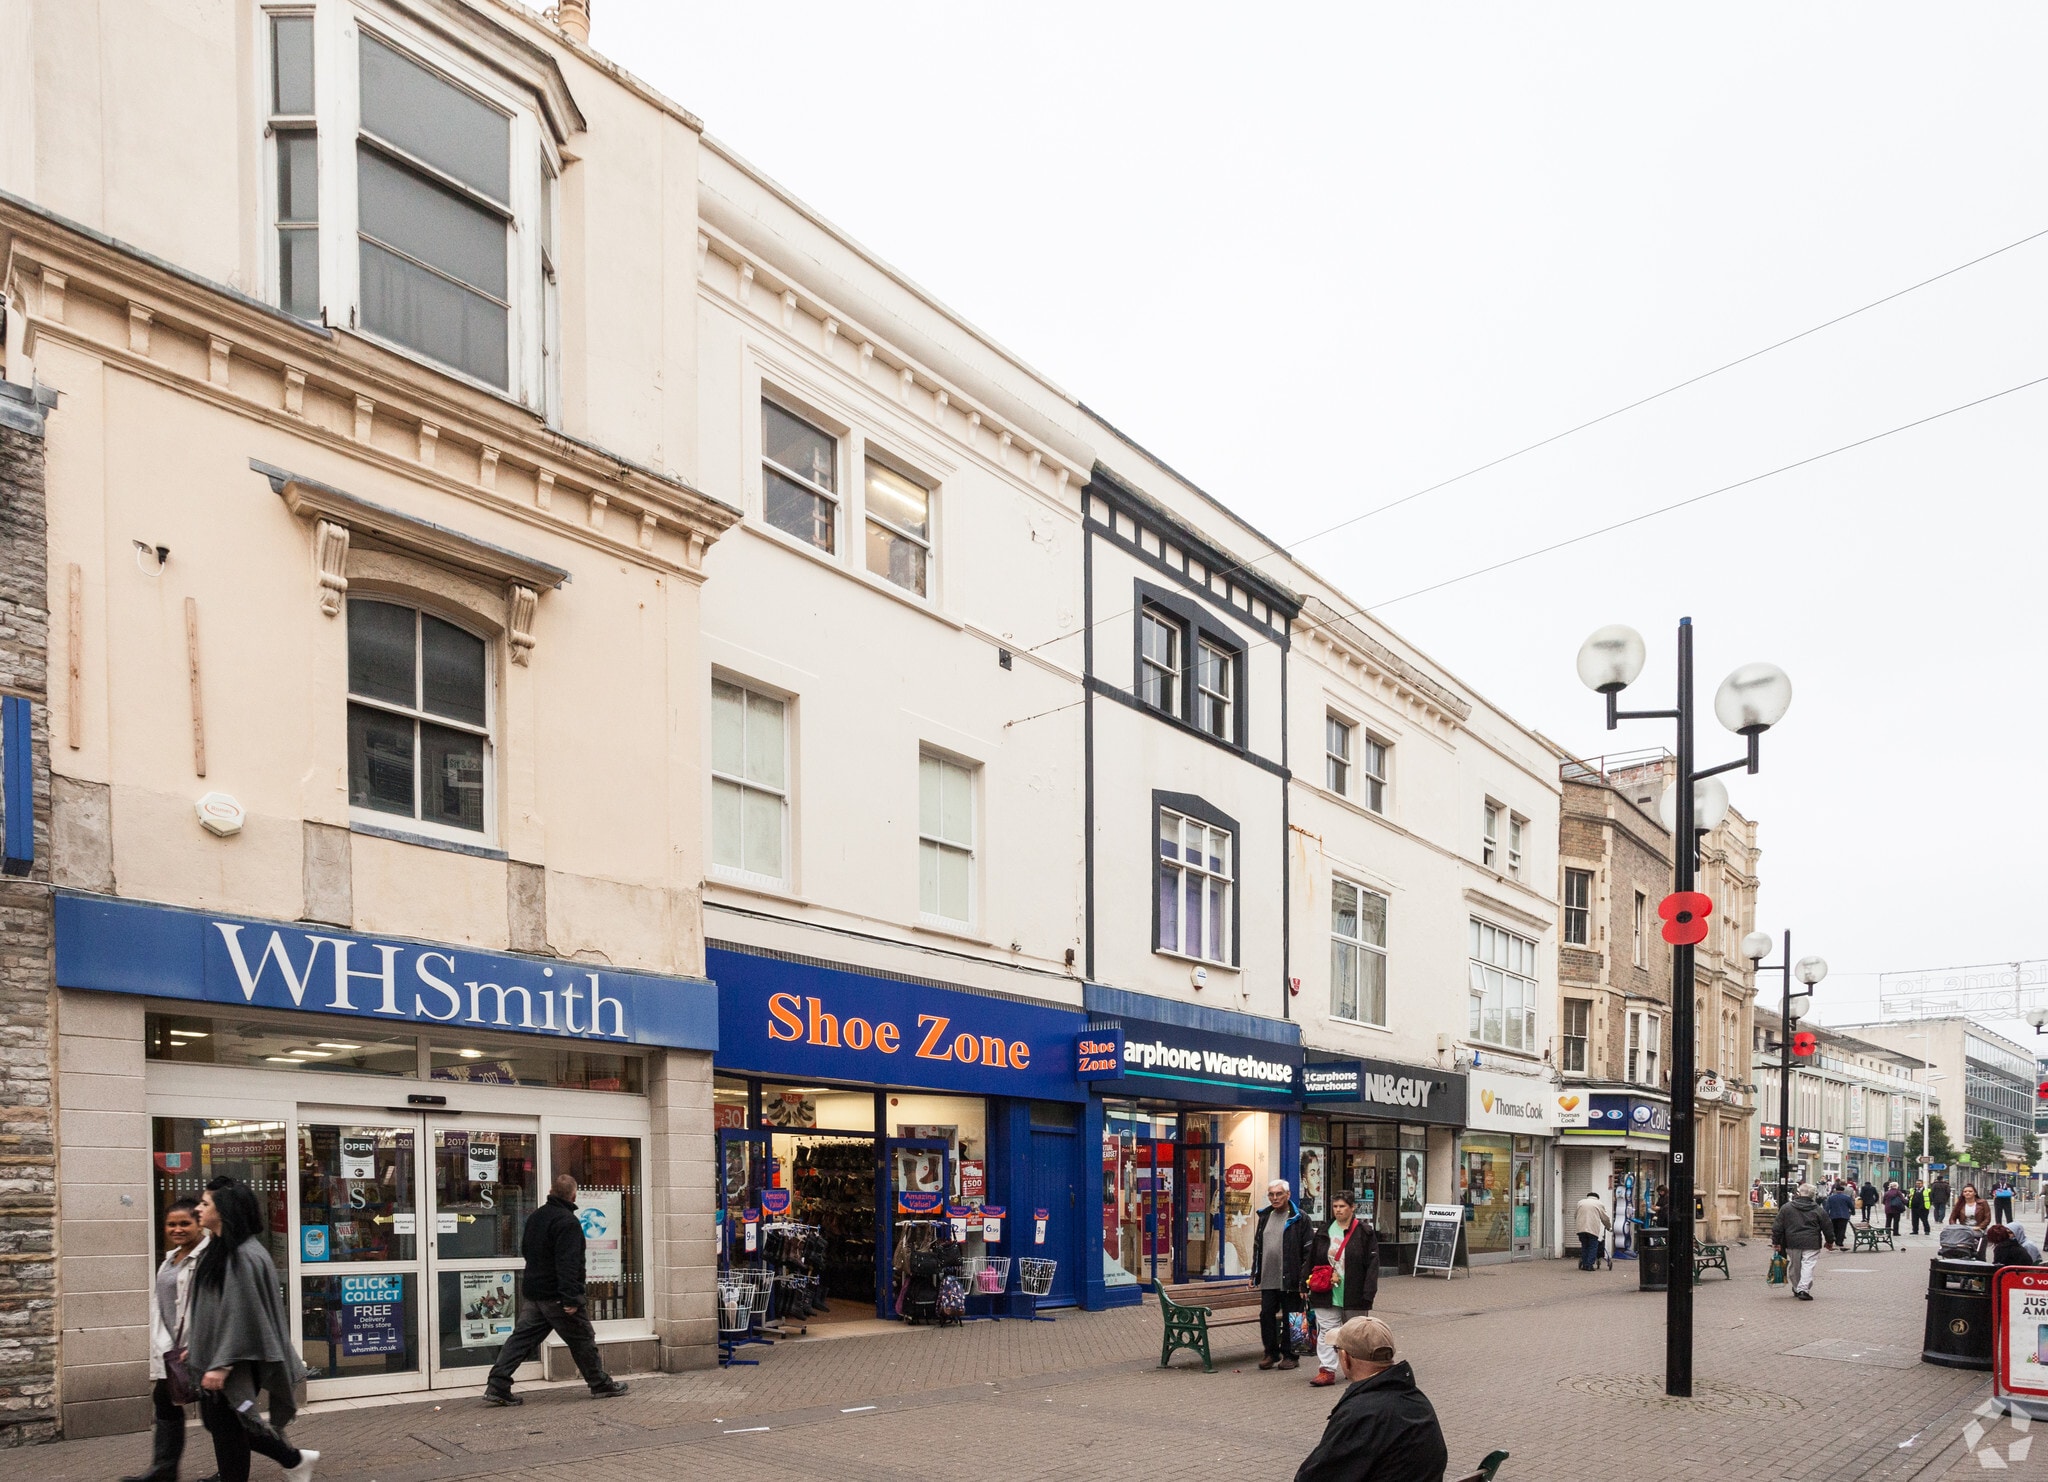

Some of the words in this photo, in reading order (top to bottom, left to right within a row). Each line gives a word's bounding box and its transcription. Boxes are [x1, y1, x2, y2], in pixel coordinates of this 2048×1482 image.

[212, 922, 630, 1039] WHSmith
[767, 992, 900, 1054] Shoe
[915, 1013, 1031, 1070] Zone
[1079, 1040, 1116, 1055] Shoe
[1078, 1057, 1117, 1072] Zone
[1123, 1041, 1201, 1070] arphone
[1202, 1050, 1293, 1083] Warehouse
[1310, 1071, 1357, 1083] Carphone
[1305, 1081, 1357, 1092] Warehouse
[1365, 1072, 1433, 1108] NI&GUY
[1699, 1085, 1722, 1093] HSBC
[1495, 1097, 1525, 1118] Thomas
[1525, 1102, 1544, 1120] Cook
[1650, 1107, 1671, 1131] Coll's
[344, 1142, 374, 1151] OPEN
[398, 1138, 413, 1147] 201
[447, 1138, 466, 1146] 2017
[470, 1147, 496, 1156] OPEN
[1675, 1154, 1682, 1162] 9
[962, 1179, 983, 1188] £500
[350, 1187, 366, 1209] S
[480, 1188, 494, 1209] S
[904, 1193, 937, 1202] Amazing
[909, 1200, 931, 1209] Value!
[985, 1224, 999, 1233] 6.99
[344, 1289, 400, 1302] COLLECT
[2023, 1298, 2048, 1306] JUS
[353, 1304, 392, 1317] FREE
[2022, 1307, 2031, 1315] A
[2034, 1307, 2048, 1316] M
[351, 1344, 397, 1354] whsmith.co.uk
